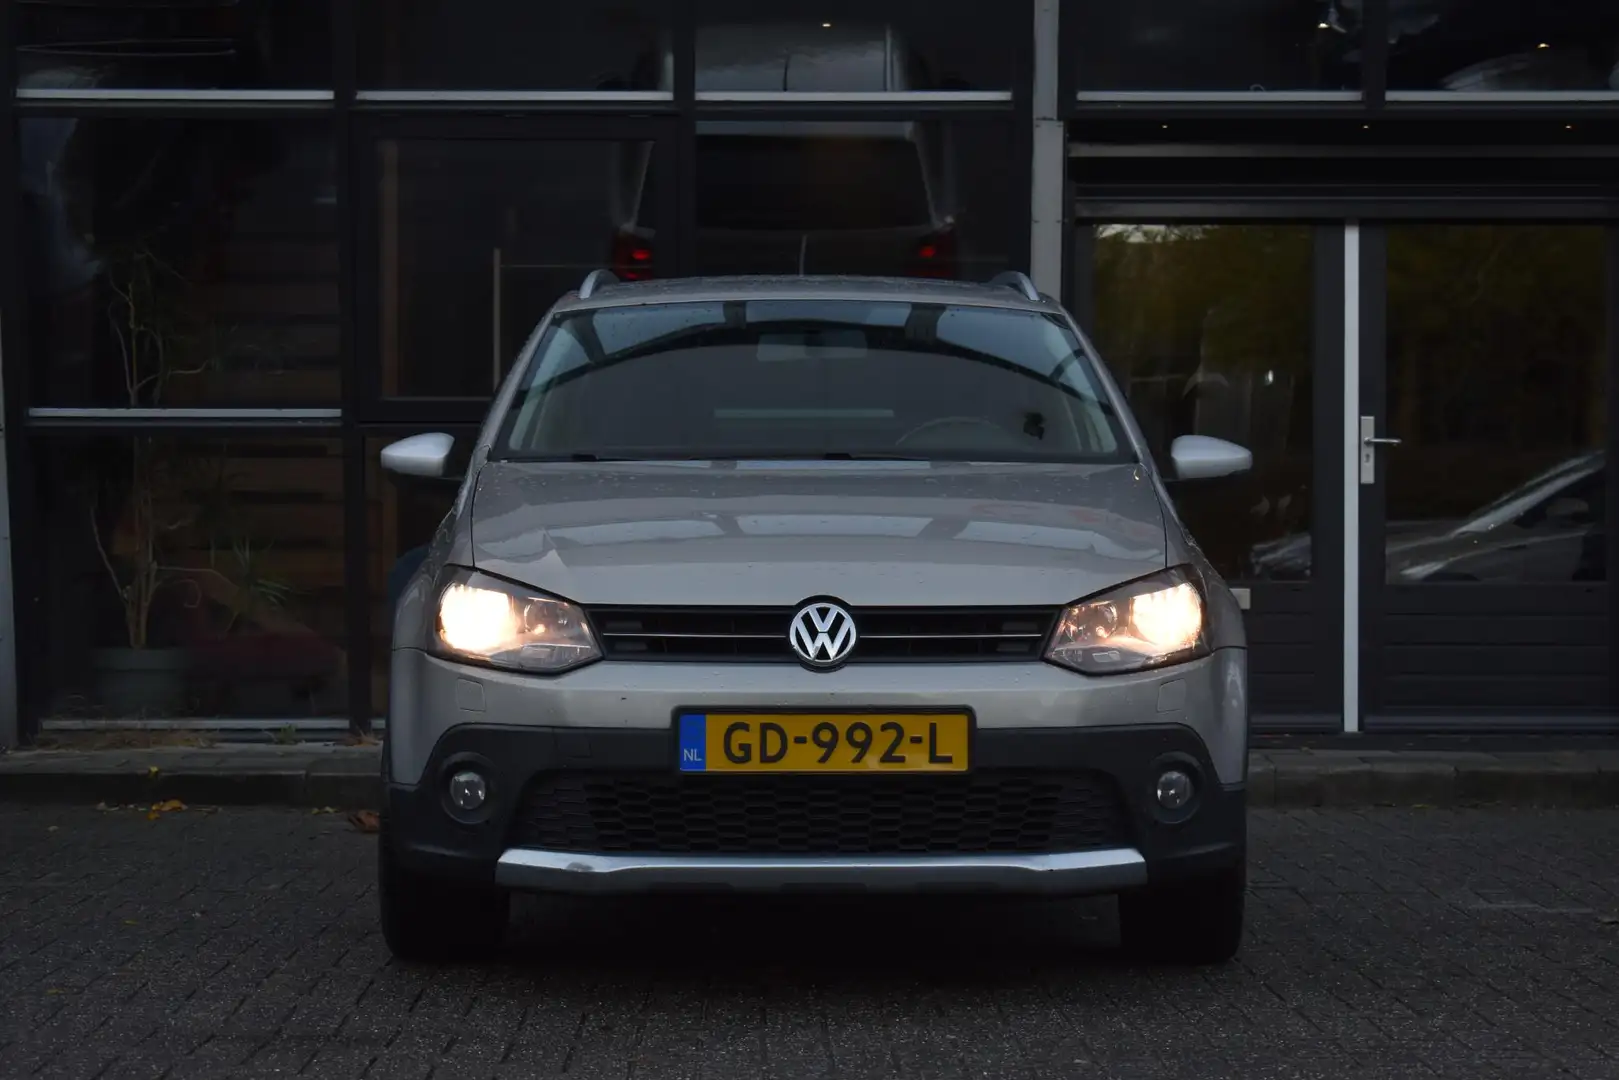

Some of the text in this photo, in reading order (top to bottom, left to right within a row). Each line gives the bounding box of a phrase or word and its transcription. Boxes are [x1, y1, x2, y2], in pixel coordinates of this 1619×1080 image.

[790, 603, 856, 662] VW
[683, 748, 703, 762] NL
[723, 721, 954, 765] GD-992-L
